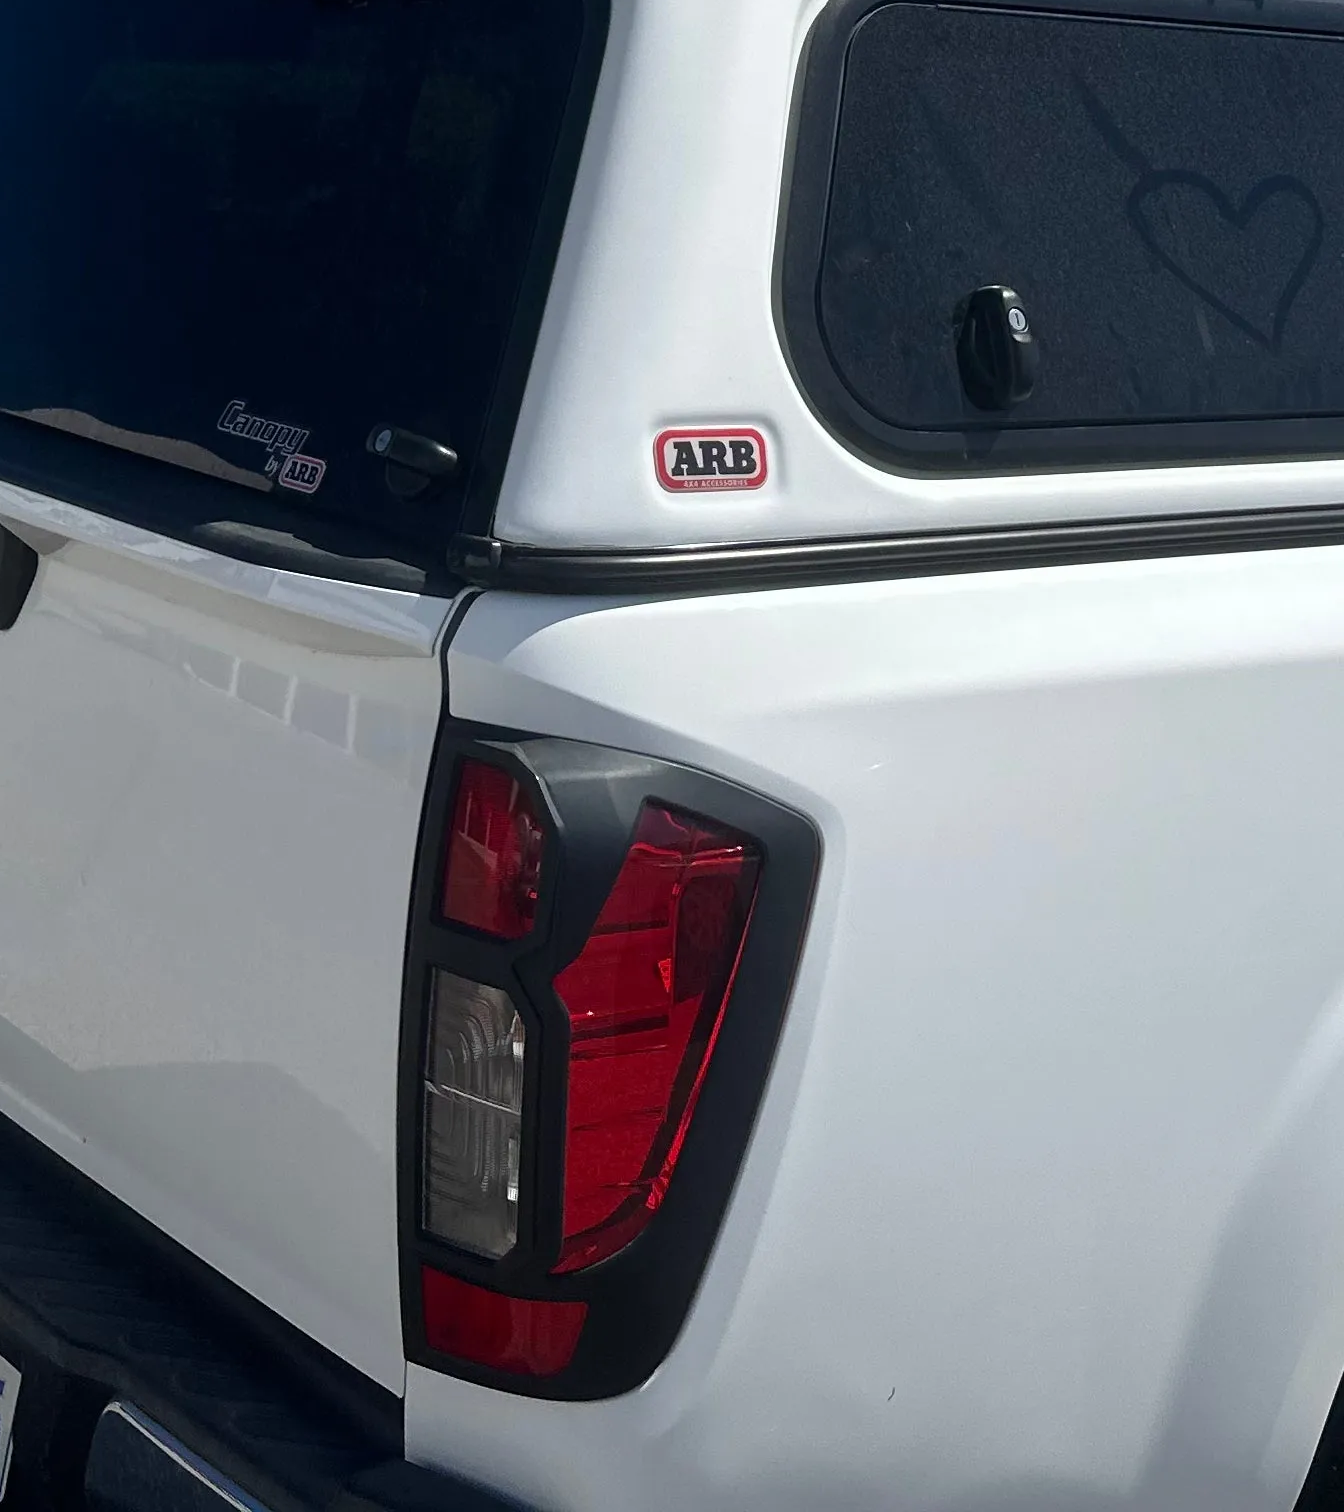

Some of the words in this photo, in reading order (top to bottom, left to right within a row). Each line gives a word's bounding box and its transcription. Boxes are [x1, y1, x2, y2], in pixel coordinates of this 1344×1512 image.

[217, 399, 310, 456] Canopy
[264, 454, 281, 477] by
[284, 460, 320, 486] ARB
[670, 440, 758, 477] ARB
